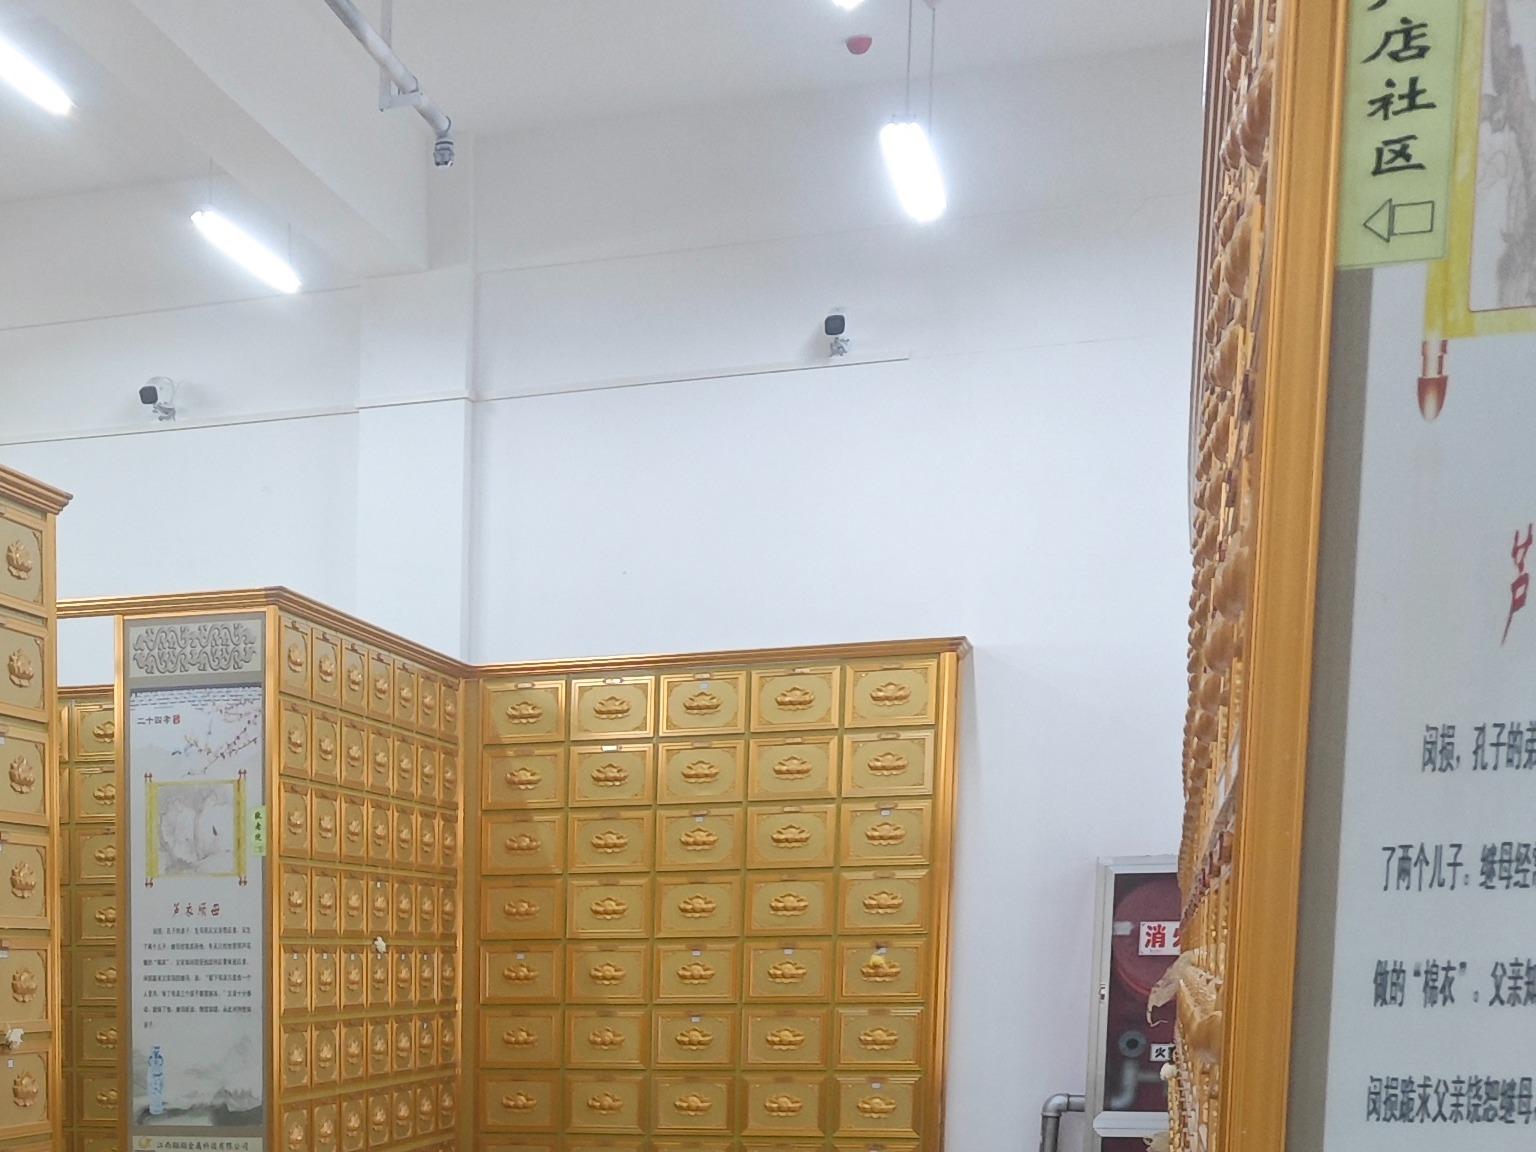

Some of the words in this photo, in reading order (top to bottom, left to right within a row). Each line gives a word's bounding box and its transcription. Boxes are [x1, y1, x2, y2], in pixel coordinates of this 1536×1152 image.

[1362, 0, 1437, 177] 店社区
[1381, 841, 1536, 892] 了两个儿子。继母经
